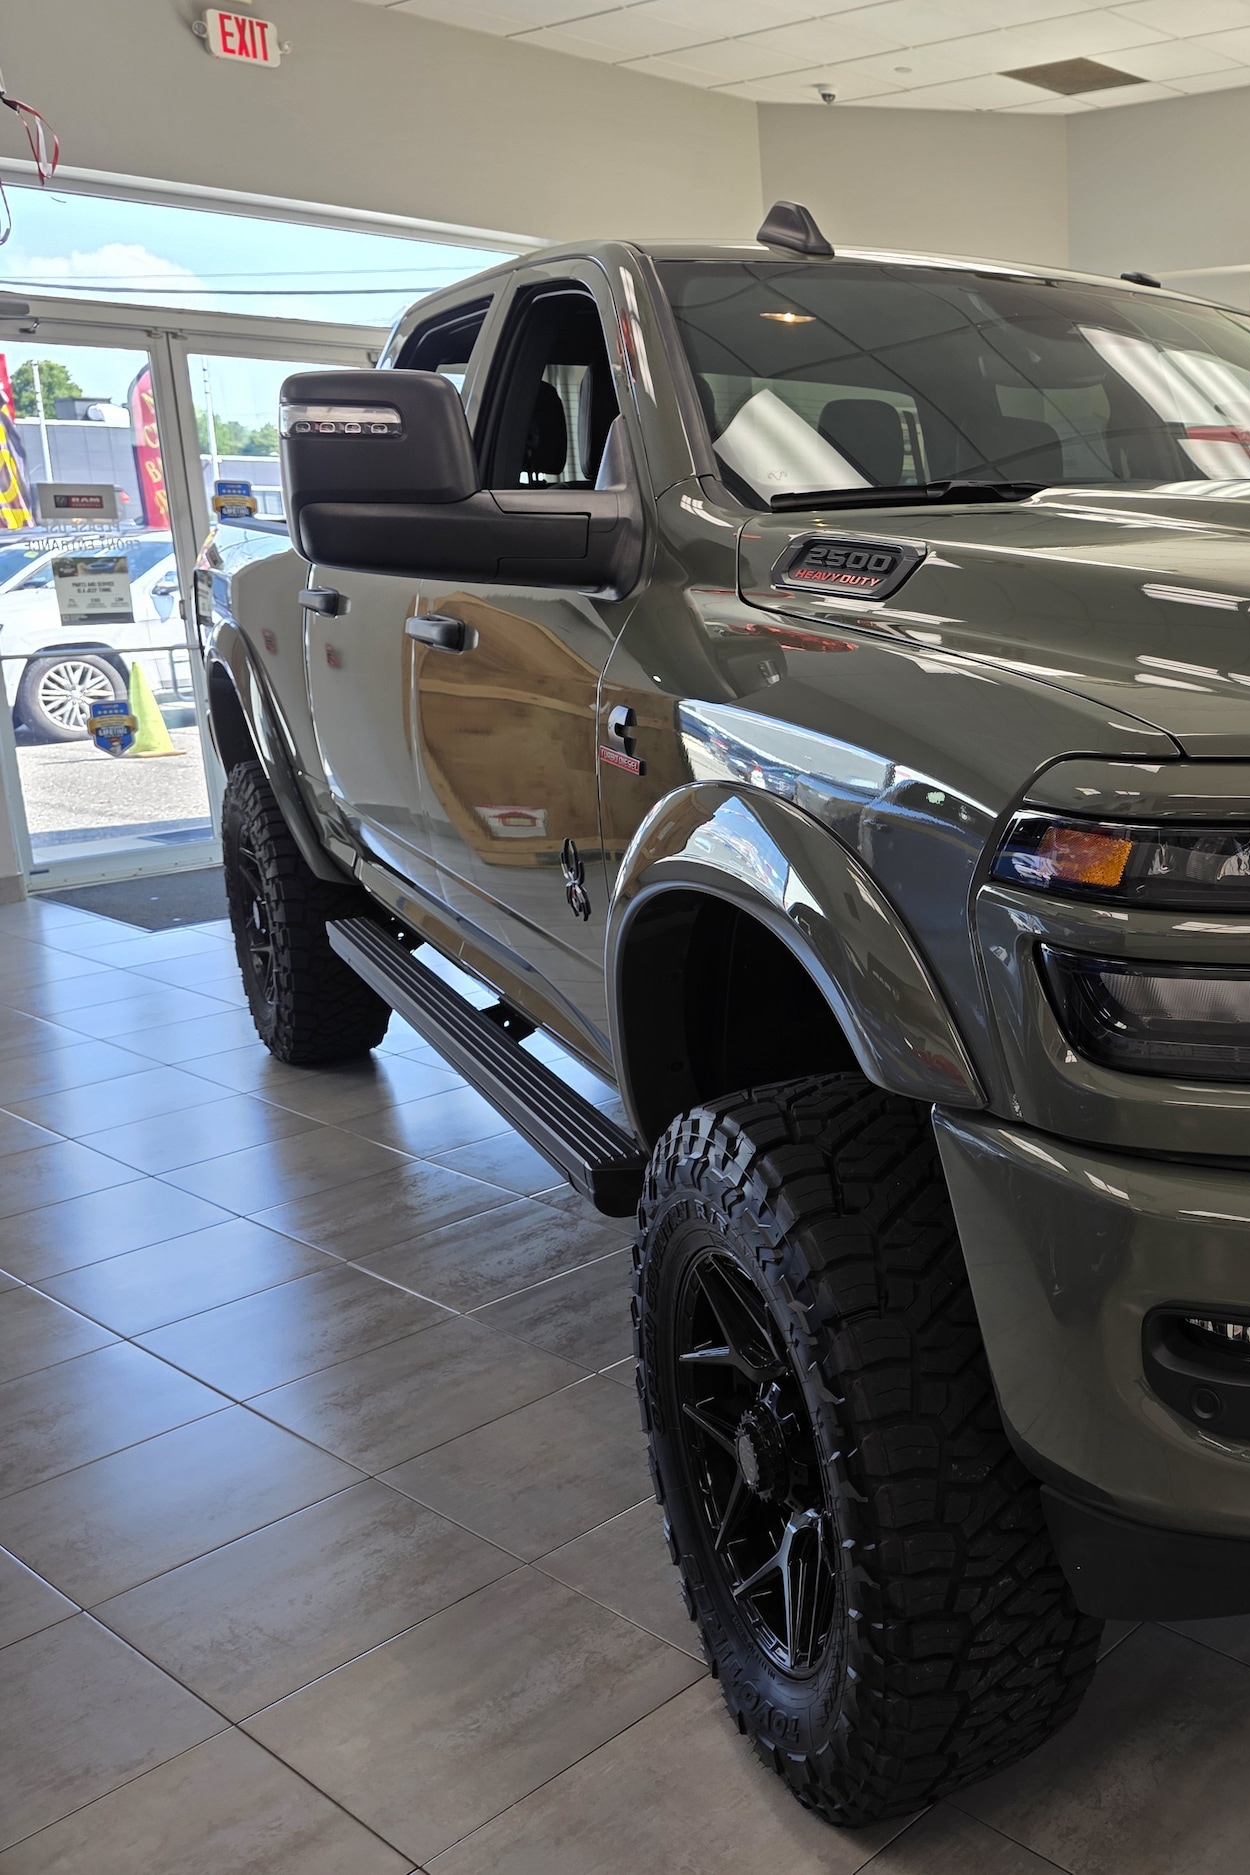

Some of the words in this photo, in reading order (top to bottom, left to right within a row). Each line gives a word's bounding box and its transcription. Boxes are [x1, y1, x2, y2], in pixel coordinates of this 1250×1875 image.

[218, 13, 268, 62] EXIT
[795, 569, 840, 583] HEAVY
[839, 574, 881, 587] DUTY
[804, 547, 894, 573] 2500
[600, 748, 619, 763] TURBO
[618, 756, 640, 772] DIESEL
[645, 1198, 690, 1312] COUNTRY
[644, 1312, 665, 1436] OPEN
[740, 1680, 801, 1744] TOYO
